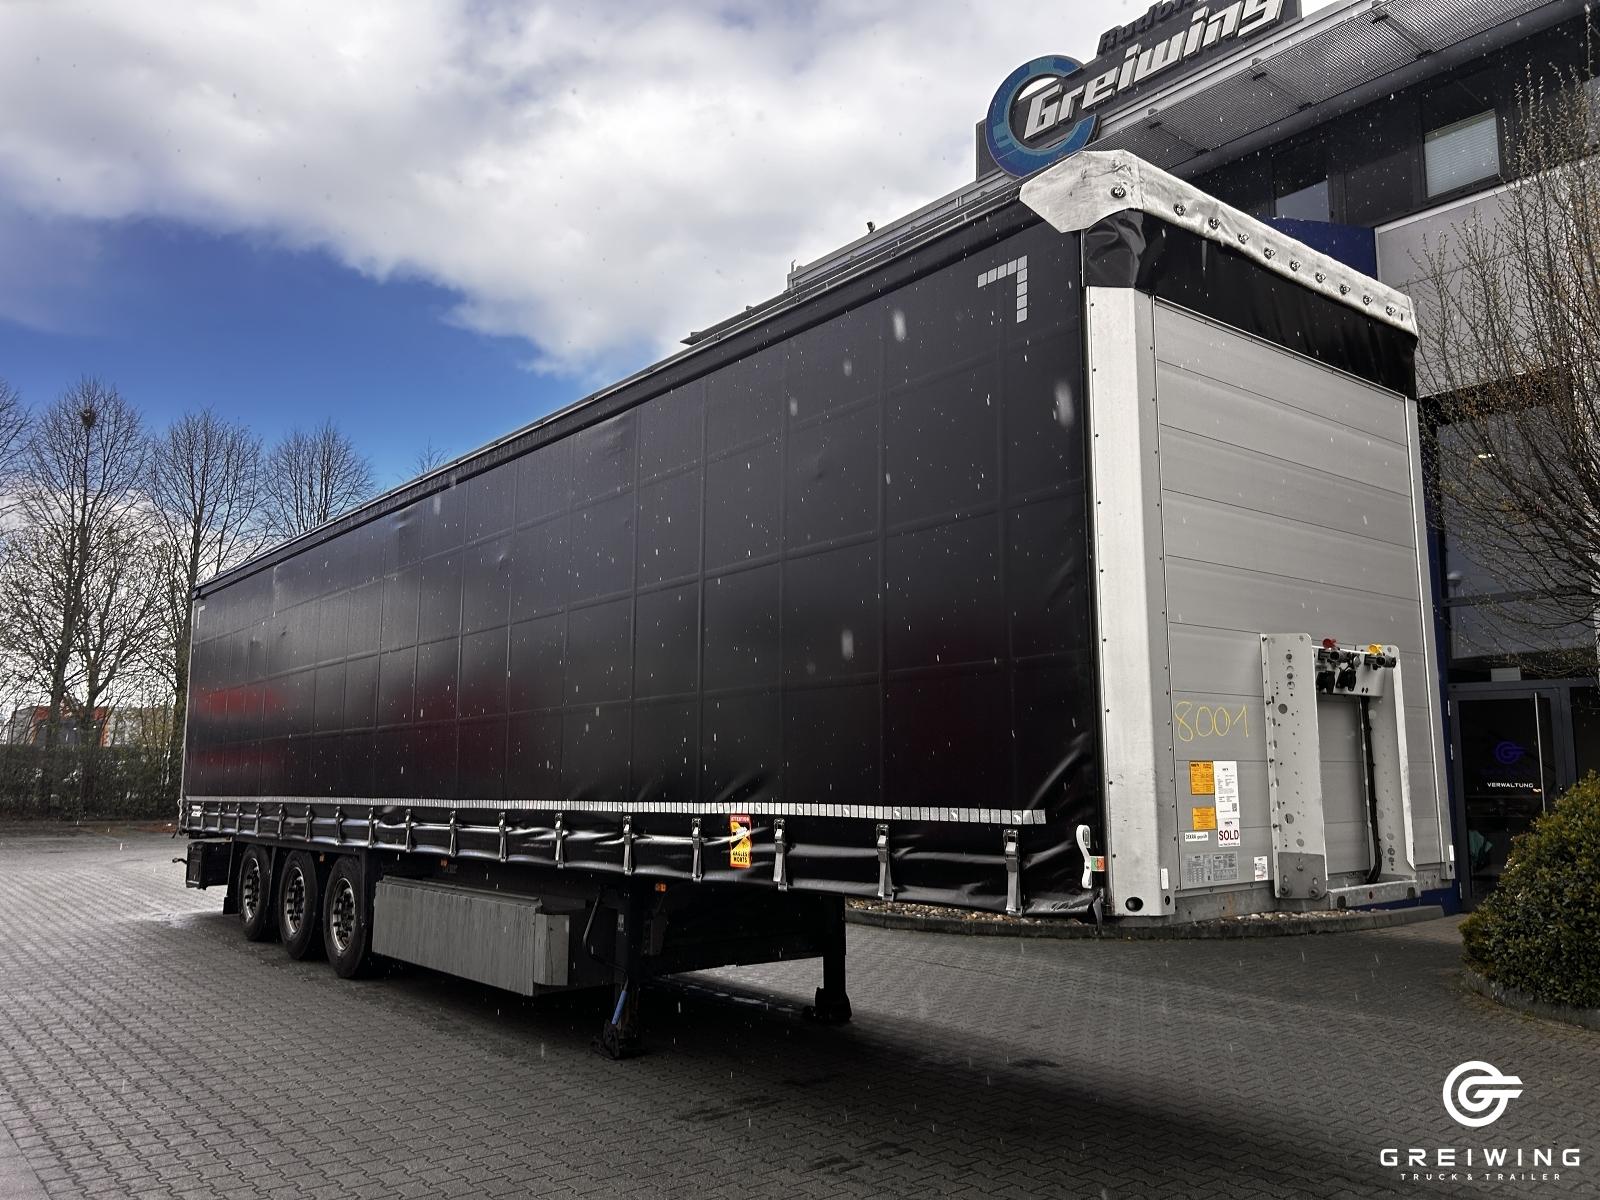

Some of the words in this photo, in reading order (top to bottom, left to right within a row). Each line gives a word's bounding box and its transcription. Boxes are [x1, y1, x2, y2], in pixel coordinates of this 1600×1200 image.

[1097, 0, 1196, 54] Rudol
[1023, 0, 1284, 140] Greiwing
[1175, 701, 1249, 742] 8001
[1218, 829, 1240, 841] SOLD
